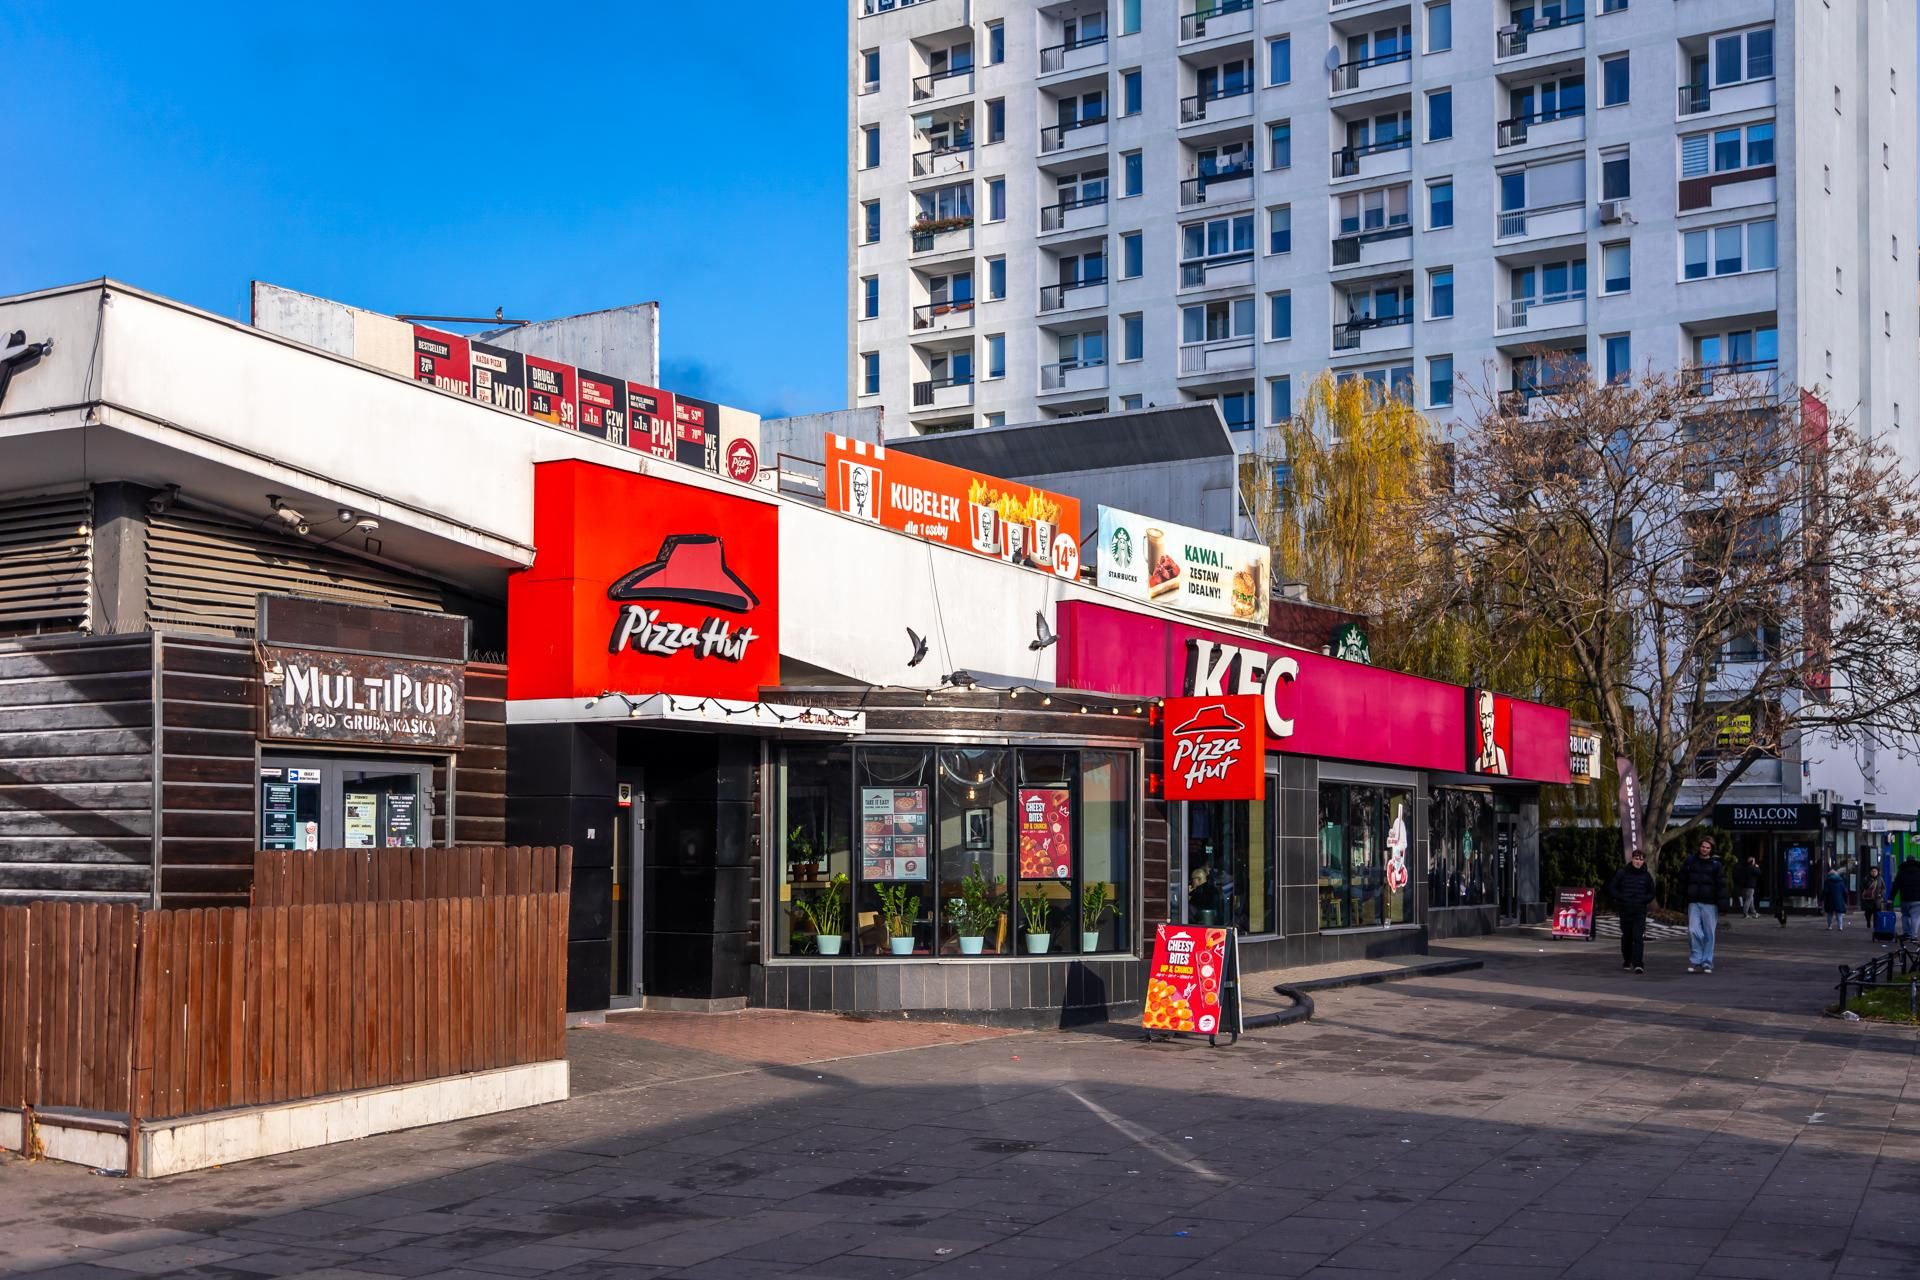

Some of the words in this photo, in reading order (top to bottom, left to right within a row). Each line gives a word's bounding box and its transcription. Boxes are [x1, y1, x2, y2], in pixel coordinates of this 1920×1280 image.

[532, 367, 555, 385] DRUGA
[494, 382, 524, 413] WTO
[561, 398, 574, 423] ŚR
[606, 410, 624, 427] CZW
[606, 426, 624, 444] ART
[651, 417, 673, 452] PIĄ
[704, 432, 717, 450] WE
[704, 448, 717, 470] EK
[731, 455, 752, 468] Pizza
[734, 466, 750, 477] Hut
[891, 482, 961, 523] KUBEŁEK
[904, 521, 919, 535] dla
[925, 522, 949, 541] osoby
[1184, 544, 1219, 568] KAWA
[1108, 570, 1138, 583] STARBUCKS
[1190, 566, 1220, 584] ZESTAW
[1188, 582, 1221, 600] IDEALNY!
[611, 604, 699, 655] Pizza
[699, 616, 760, 662] Hut
[1188, 638, 1299, 738] KFC
[304, 713, 336, 729] POD
[343, 715, 390, 734] GRUBĄ
[1172, 733, 1242, 771] Pizza
[1184, 755, 1239, 790] Hut
[1733, 807, 1798, 820] BIALCON
[1841, 808, 1859, 821] BIALCON
[1167, 939, 1195, 953] CHEESY
[1168, 952, 1190, 965] BITES
